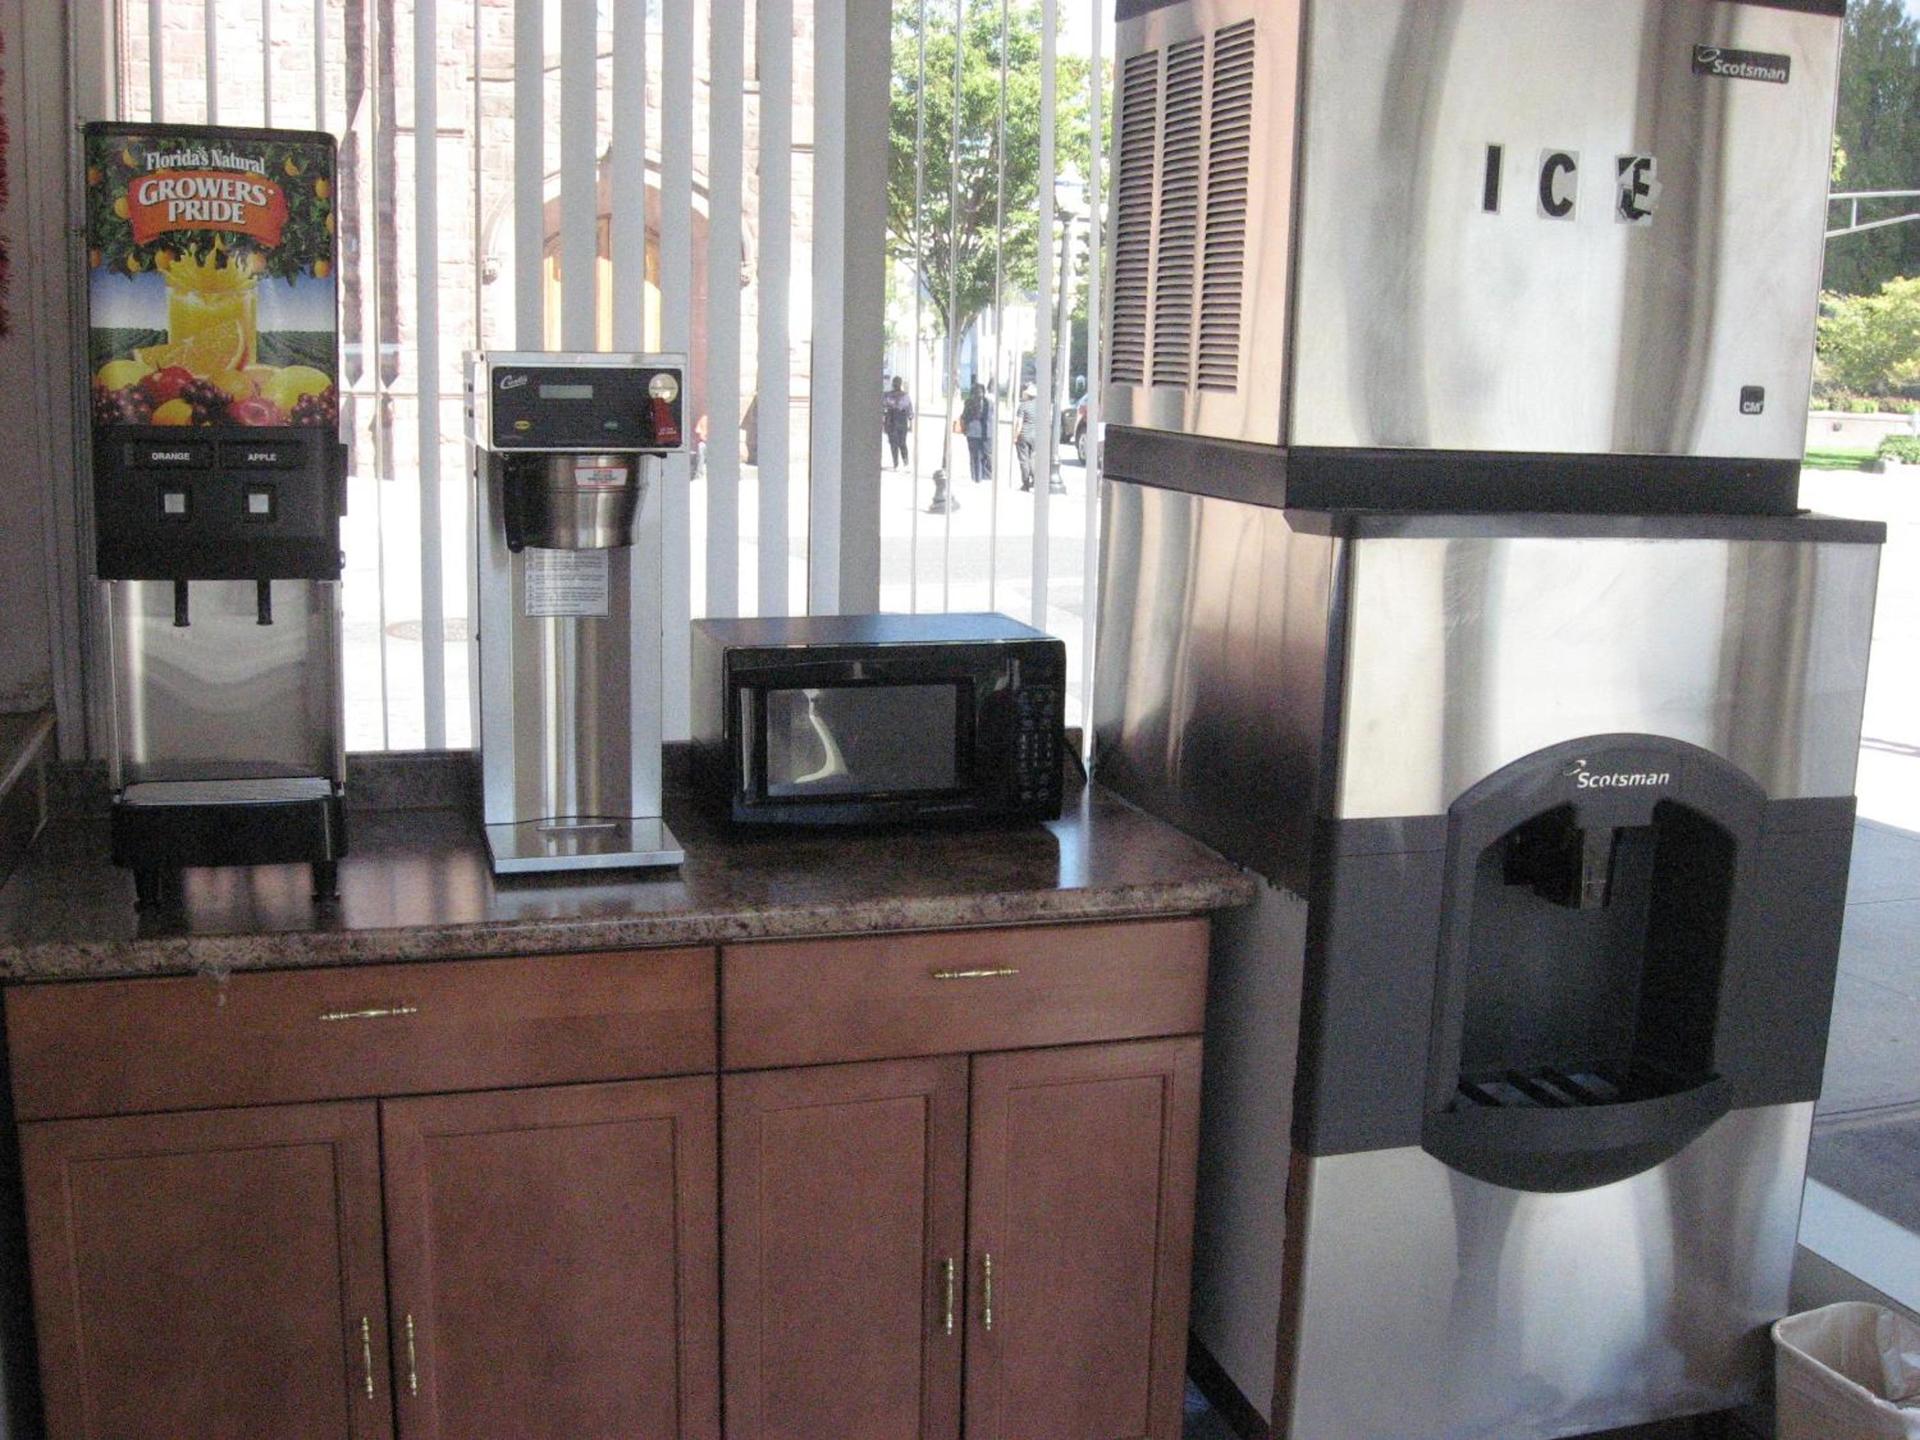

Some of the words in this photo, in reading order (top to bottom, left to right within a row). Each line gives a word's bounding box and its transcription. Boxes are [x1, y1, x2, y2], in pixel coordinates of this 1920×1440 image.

[1713, 59, 1786, 81] Scotsman
[146, 147, 209, 171] Florida's
[211, 149, 265, 174] Natural
[1484, 145, 1652, 220] ICE
[168, 200, 246, 224] PRIDE
[151, 452, 190, 461] ORANGE
[247, 453, 278, 462] APPLE
[1577, 771, 1670, 789] Scotsman
